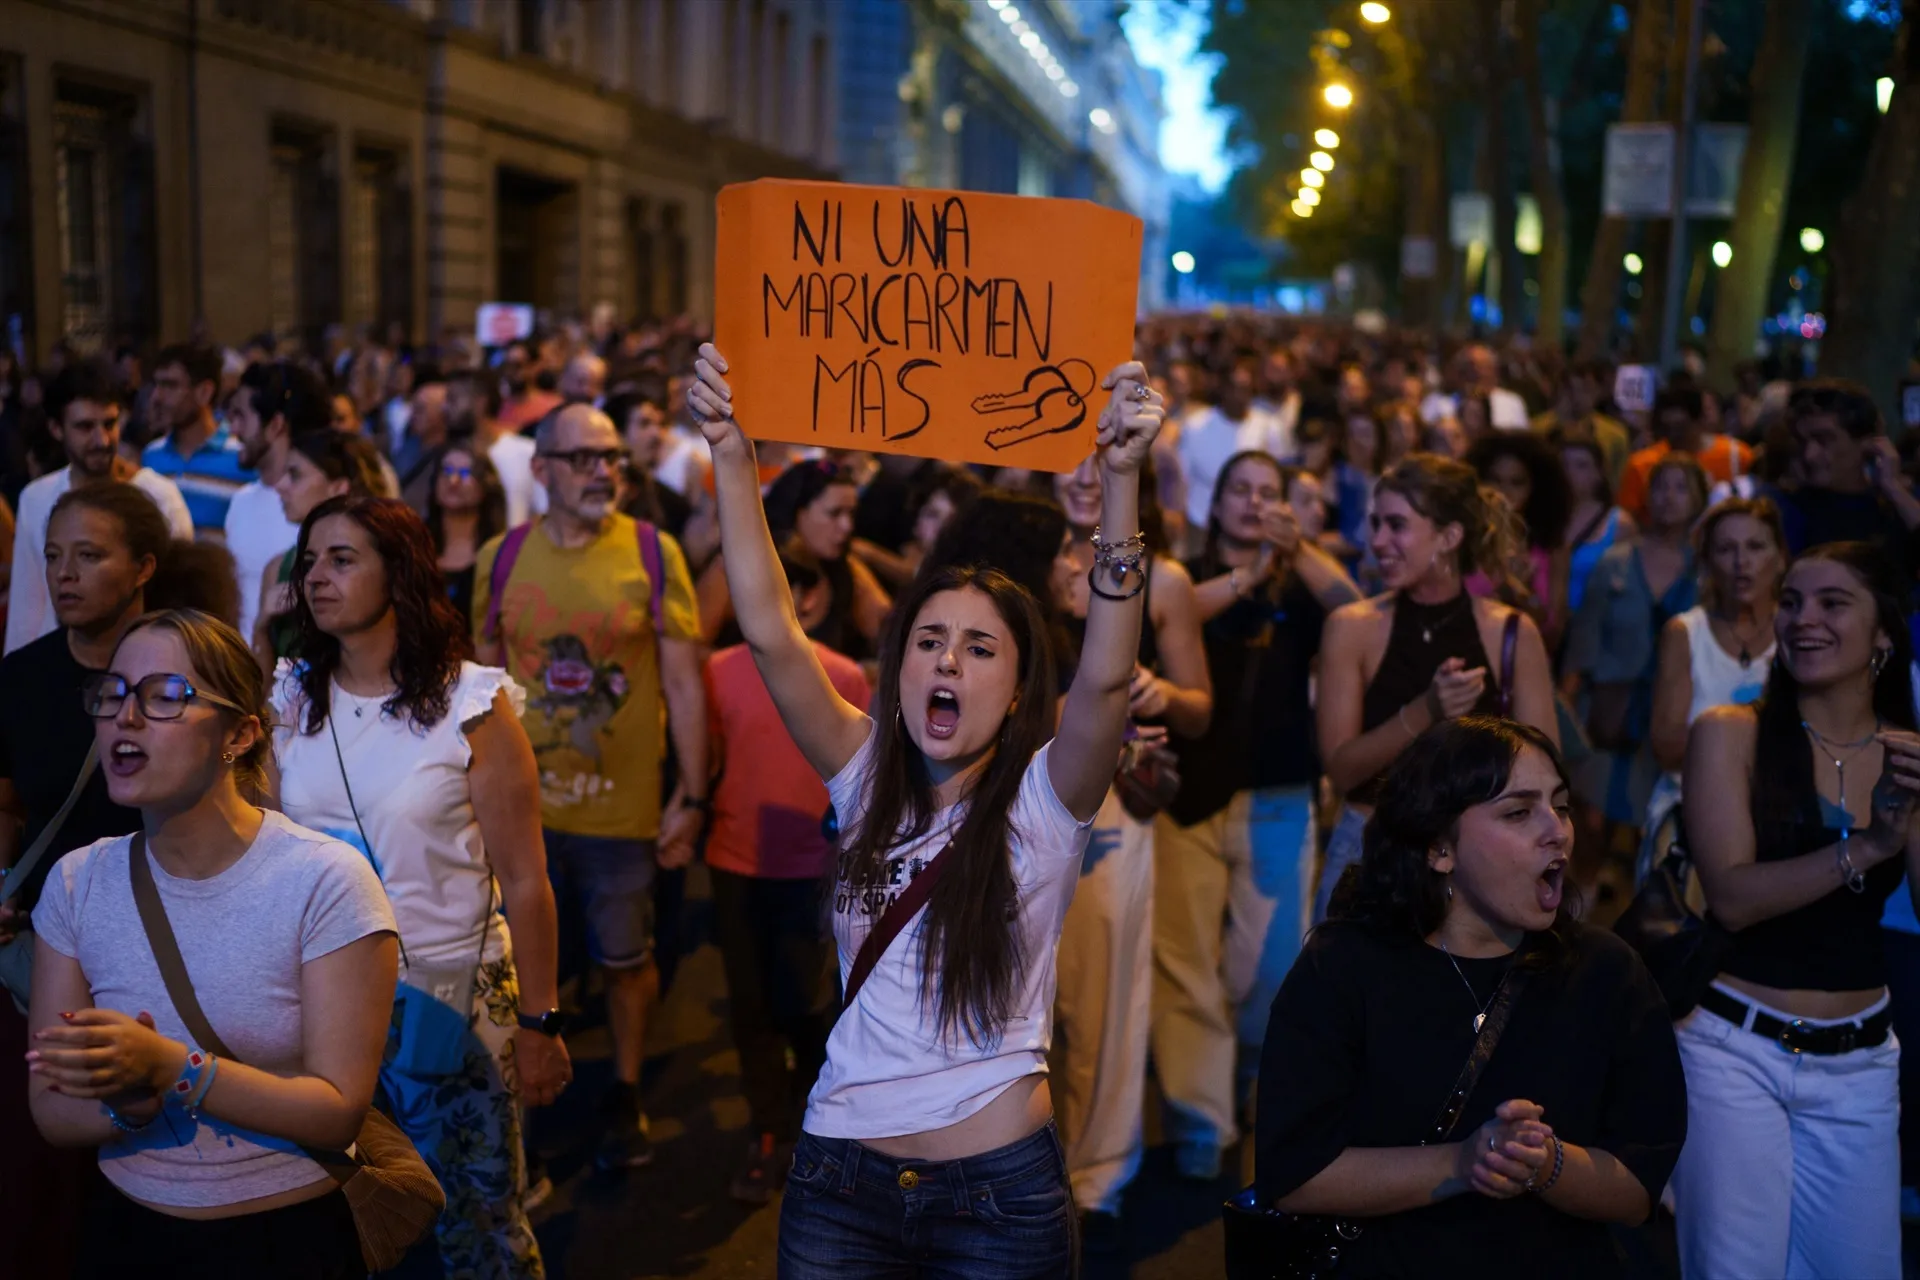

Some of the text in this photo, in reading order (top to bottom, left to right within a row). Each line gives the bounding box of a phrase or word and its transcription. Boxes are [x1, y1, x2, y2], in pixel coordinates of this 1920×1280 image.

[793, 196, 970, 271] NI UNA
[763, 272, 1053, 362] MARICARMEN
[813, 347, 942, 441] MÁS
